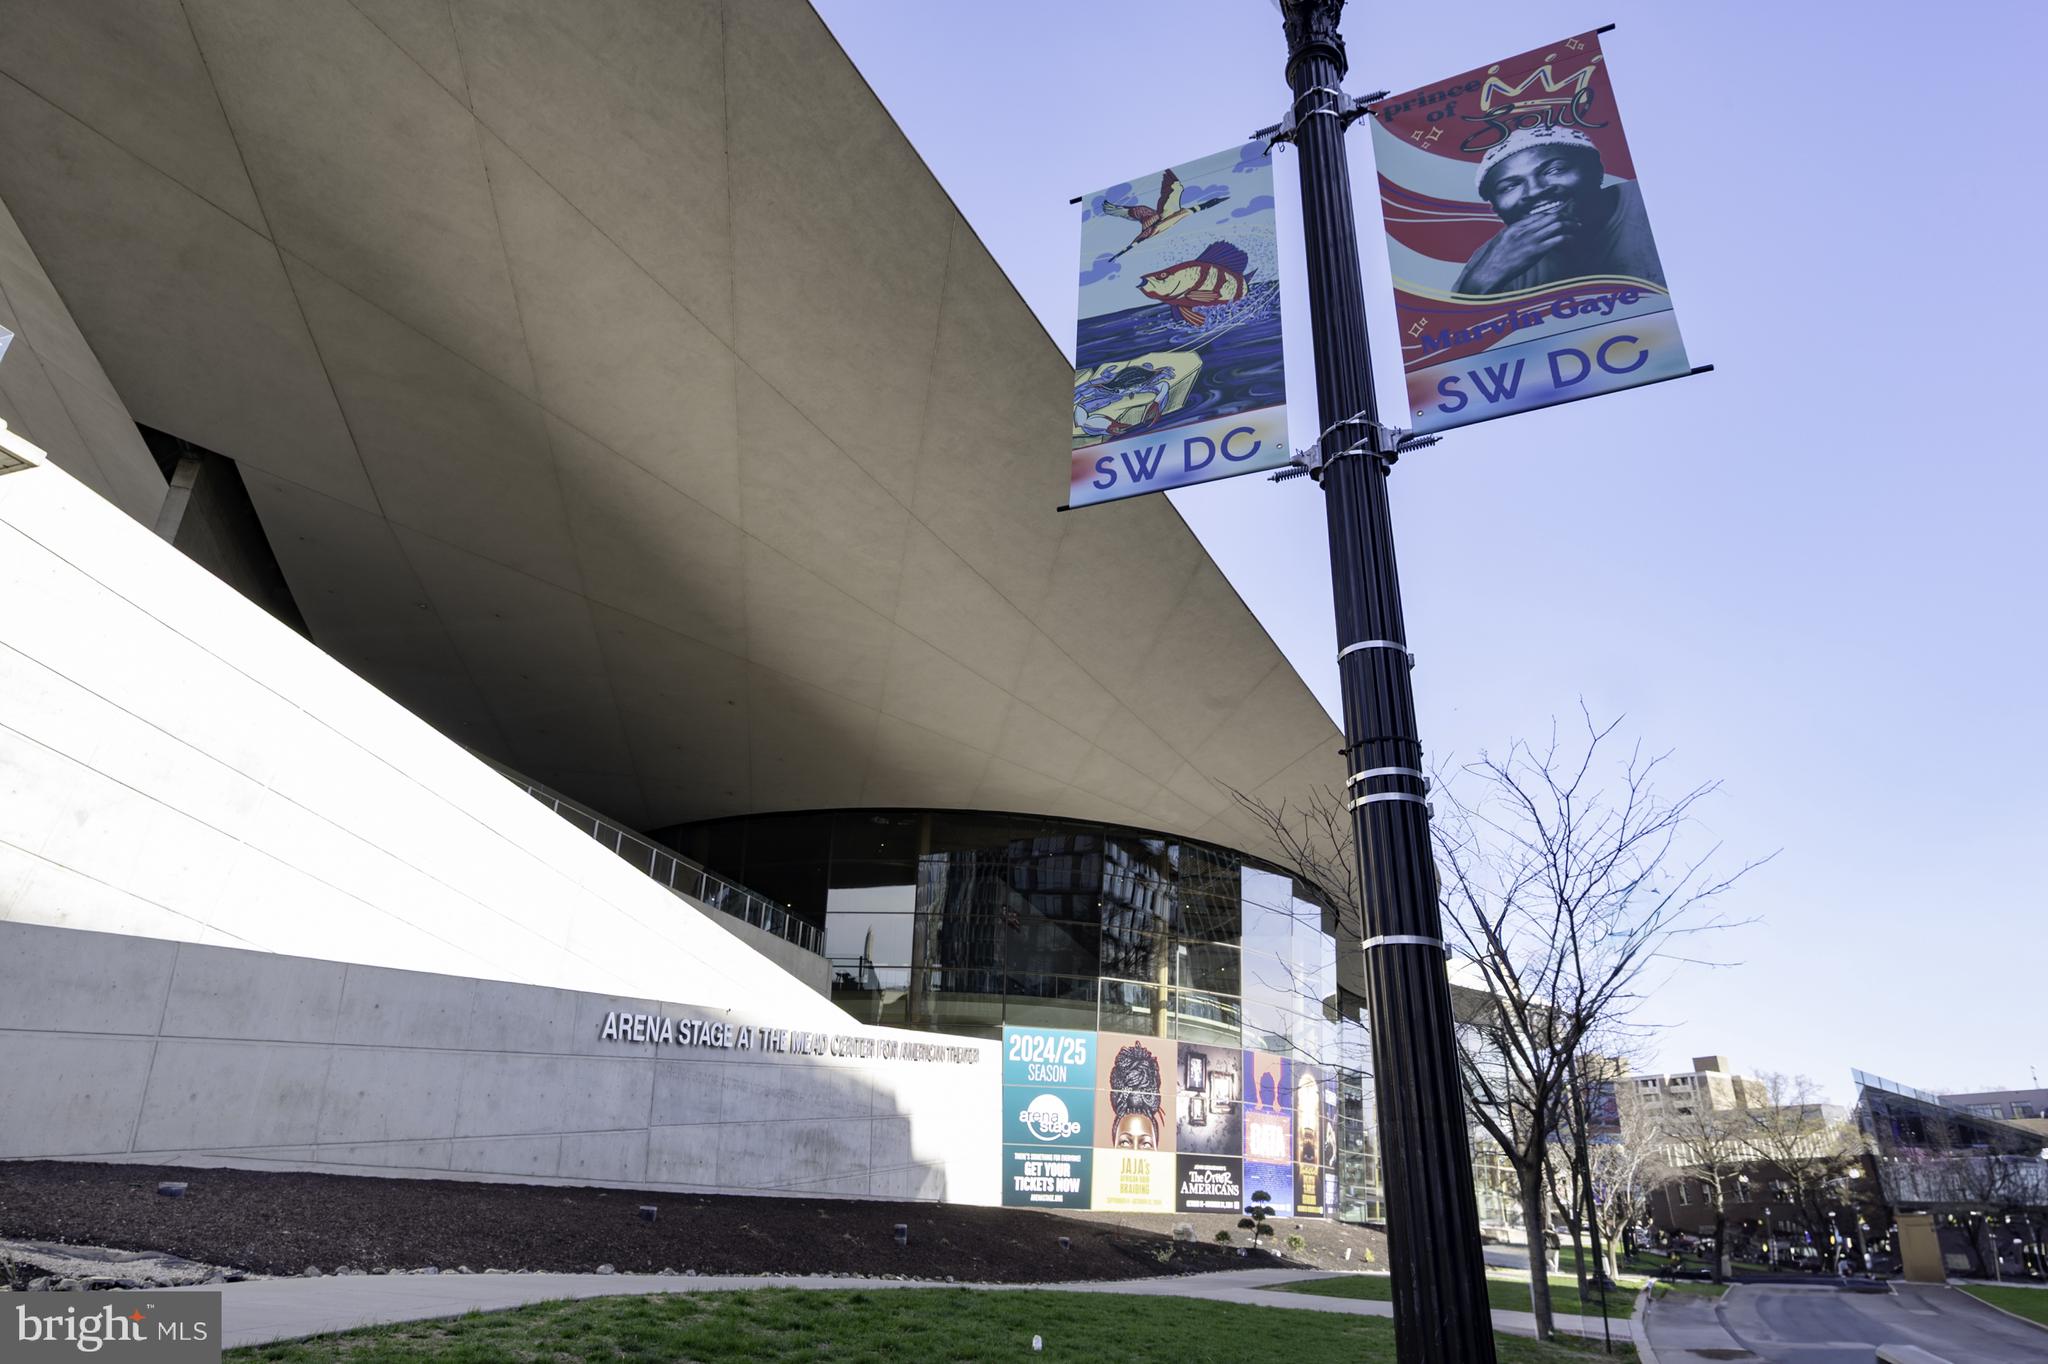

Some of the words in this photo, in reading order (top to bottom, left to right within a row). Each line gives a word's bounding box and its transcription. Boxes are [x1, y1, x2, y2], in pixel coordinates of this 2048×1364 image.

[1383, 79, 1481, 122] prince
[1425, 101, 1457, 123] of
[1421, 307, 1546, 354] Marvin
[1549, 288, 1640, 320] Gaye
[1437, 358, 1526, 414] SW
[1547, 335, 1649, 389] DC
[1092, 443, 1167, 490] SW
[1183, 426, 1262, 473] DC
[601, 1011, 673, 1044] ARENA
[677, 1018, 733, 1049] STAGE
[736, 1025, 756, 1049] AT
[759, 1027, 788, 1053] THE
[790, 1030, 829, 1056] MEAD
[830, 1034, 875, 1059] CENTER
[877, 1038, 898, 1060] FOR
[1009, 1034, 1086, 1066] 2024/25
[1028, 1064, 1067, 1082] SEASON
[1019, 1109, 1059, 1123] arena
[1039, 1119, 1081, 1138] stage
[1024, 1161, 1043, 1176] GET
[1044, 1162, 1070, 1177] YOUR
[1189, 1171, 1204, 1183] The
[1014, 1176, 1054, 1192] TICKETS
[1056, 1178, 1080, 1193] NOW
[1120, 1183, 1150, 1195] BRAIDING
[1180, 1181, 1240, 1197] AMERICANS
